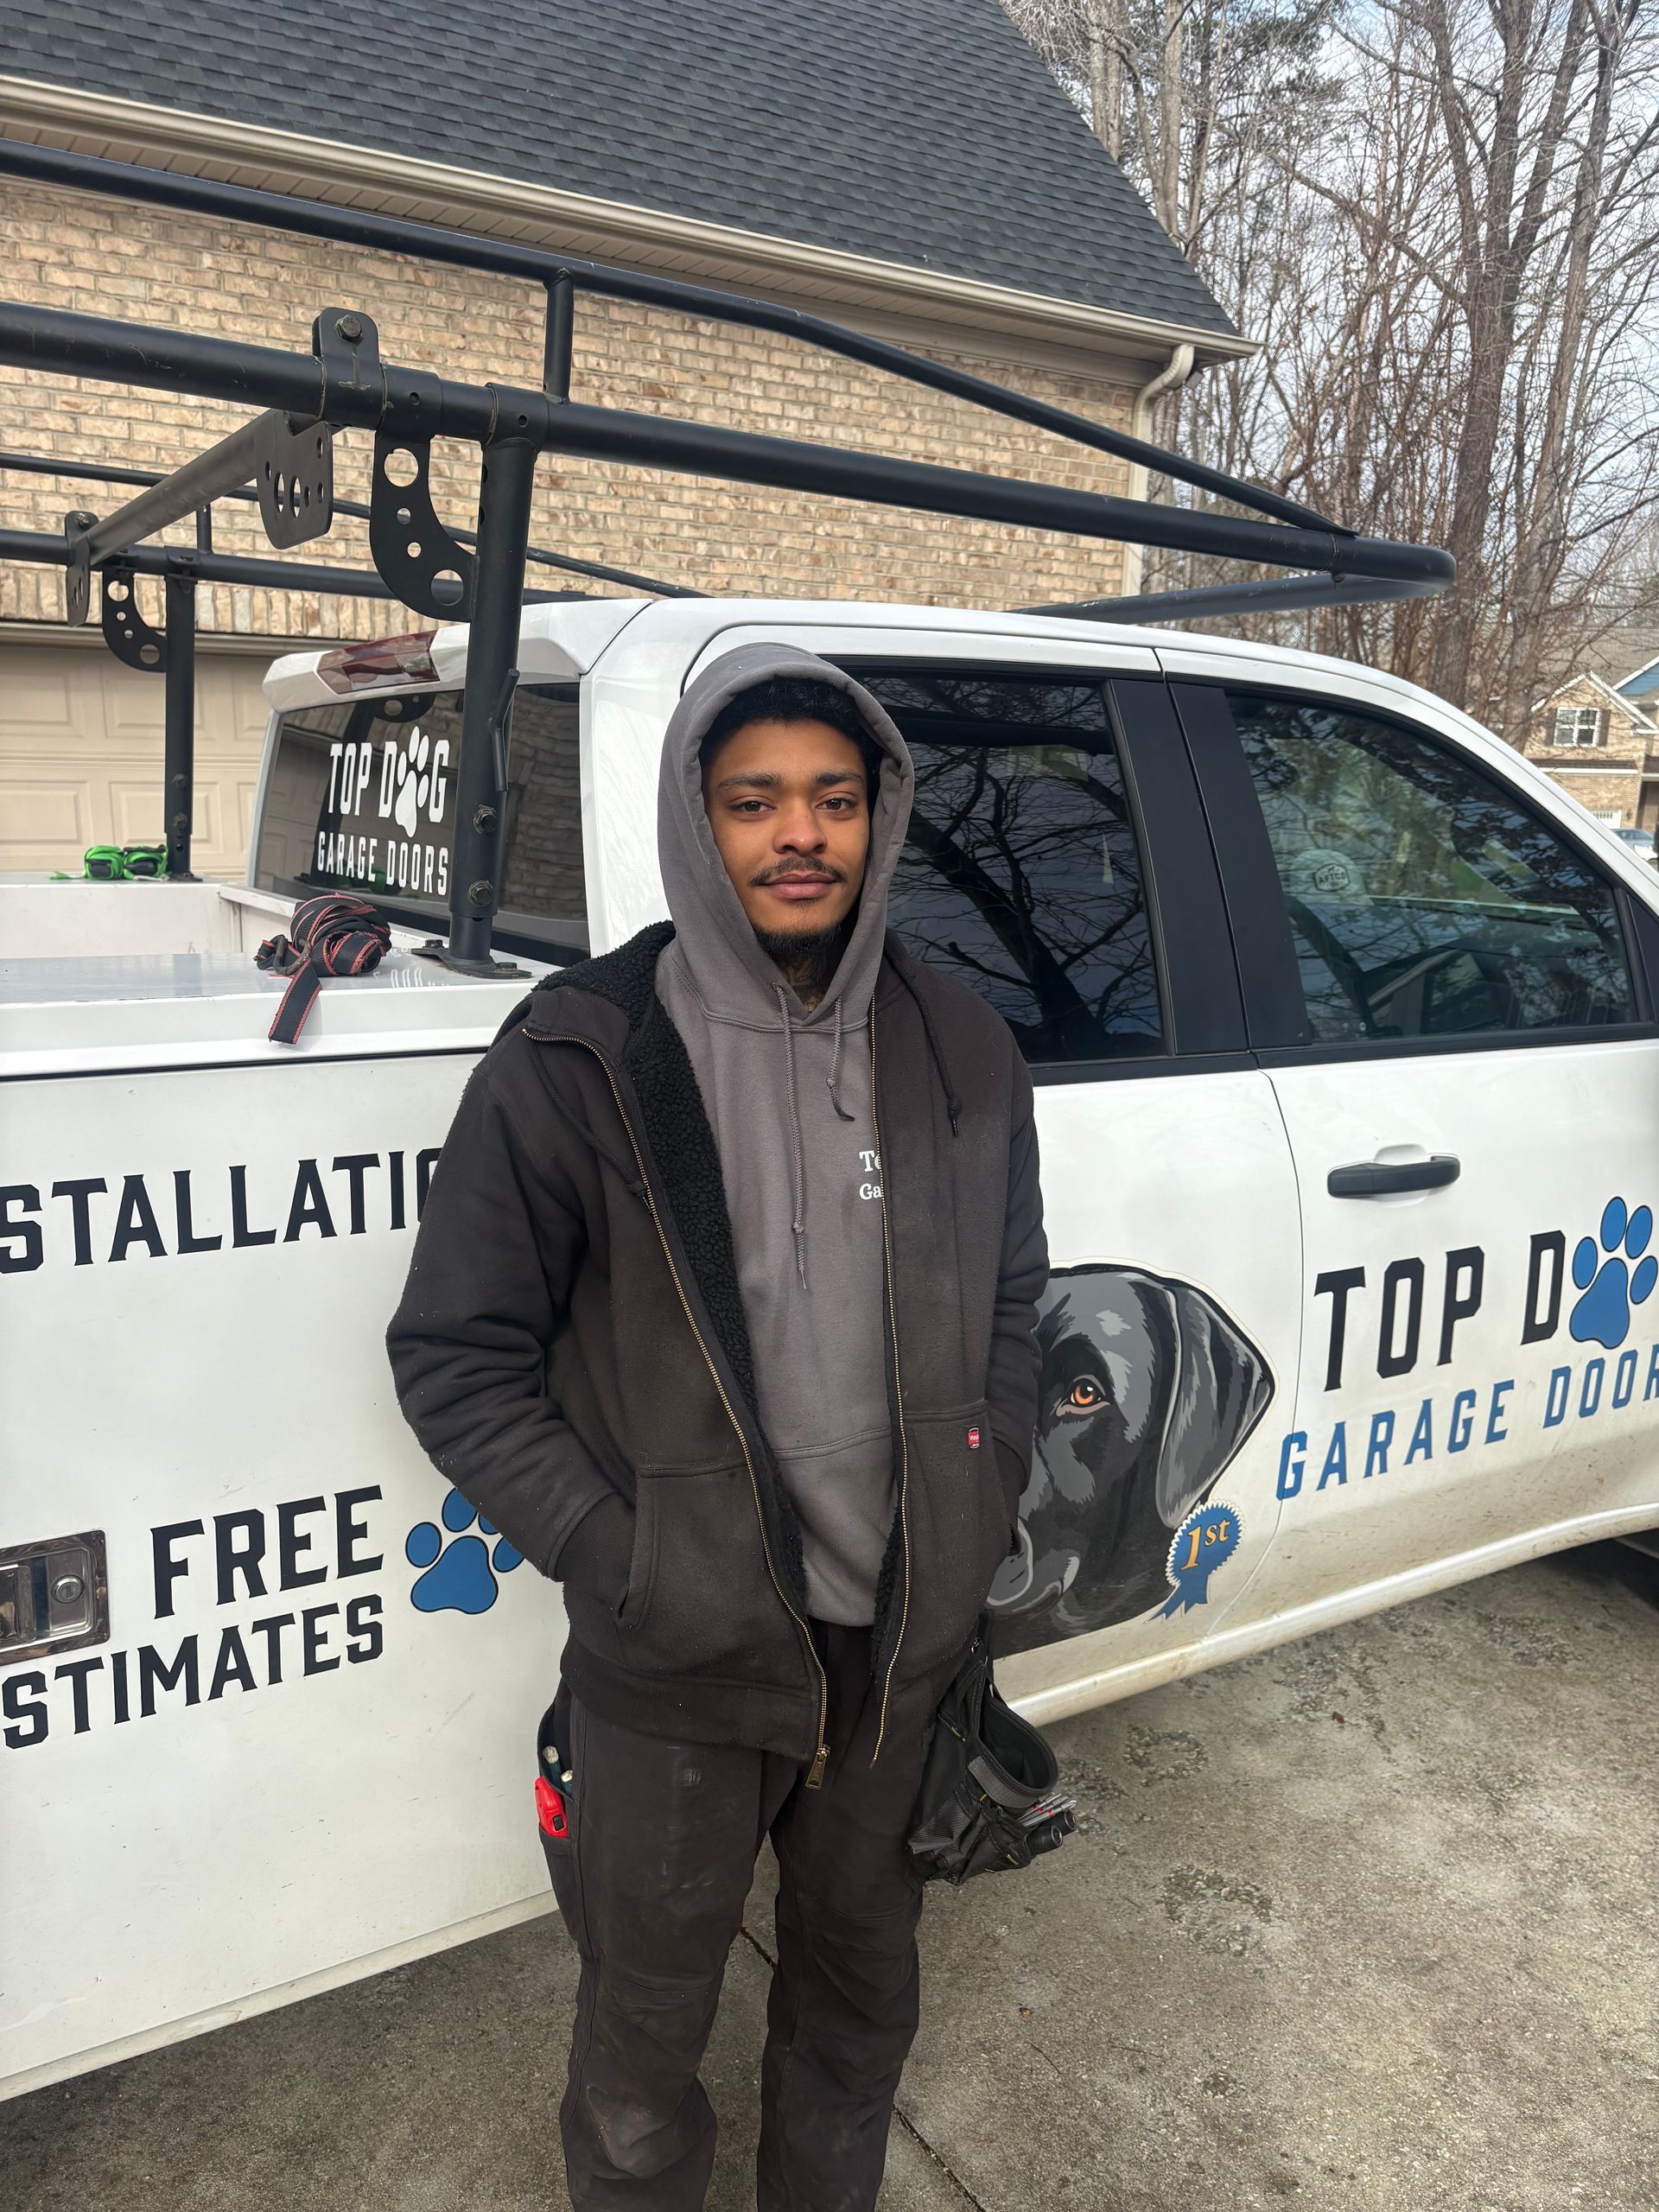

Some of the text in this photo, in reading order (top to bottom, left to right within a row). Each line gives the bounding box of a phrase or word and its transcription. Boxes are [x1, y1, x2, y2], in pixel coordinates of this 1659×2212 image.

[328, 742, 372, 816] TOP
[317, 831, 448, 895] GARAGE DOORS
[1314, 1245, 1485, 1392] TOP
[1275, 1379, 1515, 1501] GARAGE
[150, 1484, 384, 1619] FREE
[1179, 1518, 1230, 1572] 1st
[2, 1593, 384, 1750] STIMATES
